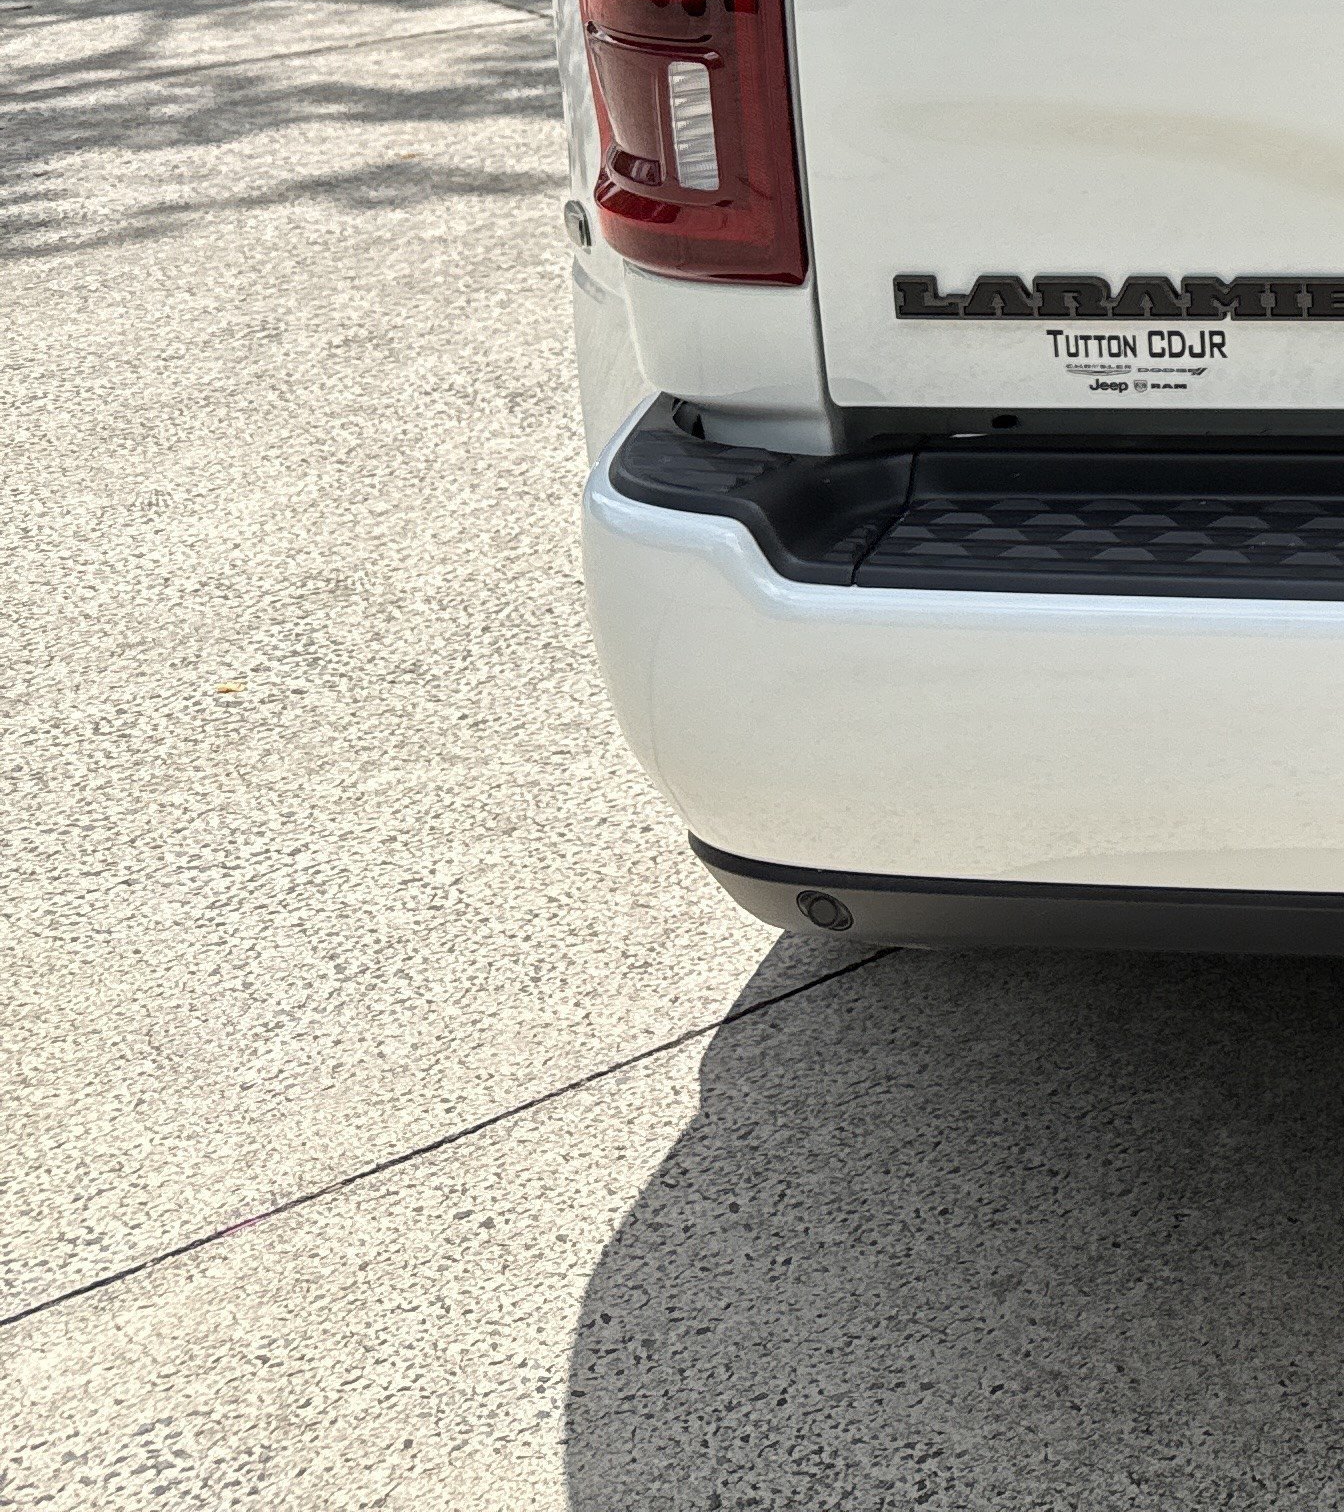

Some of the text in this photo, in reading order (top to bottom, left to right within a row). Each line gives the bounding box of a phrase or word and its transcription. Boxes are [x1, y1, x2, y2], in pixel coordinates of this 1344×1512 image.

[1046, 329, 1228, 358] TUTTON CDJR
[1089, 378, 1129, 393] Jeep
